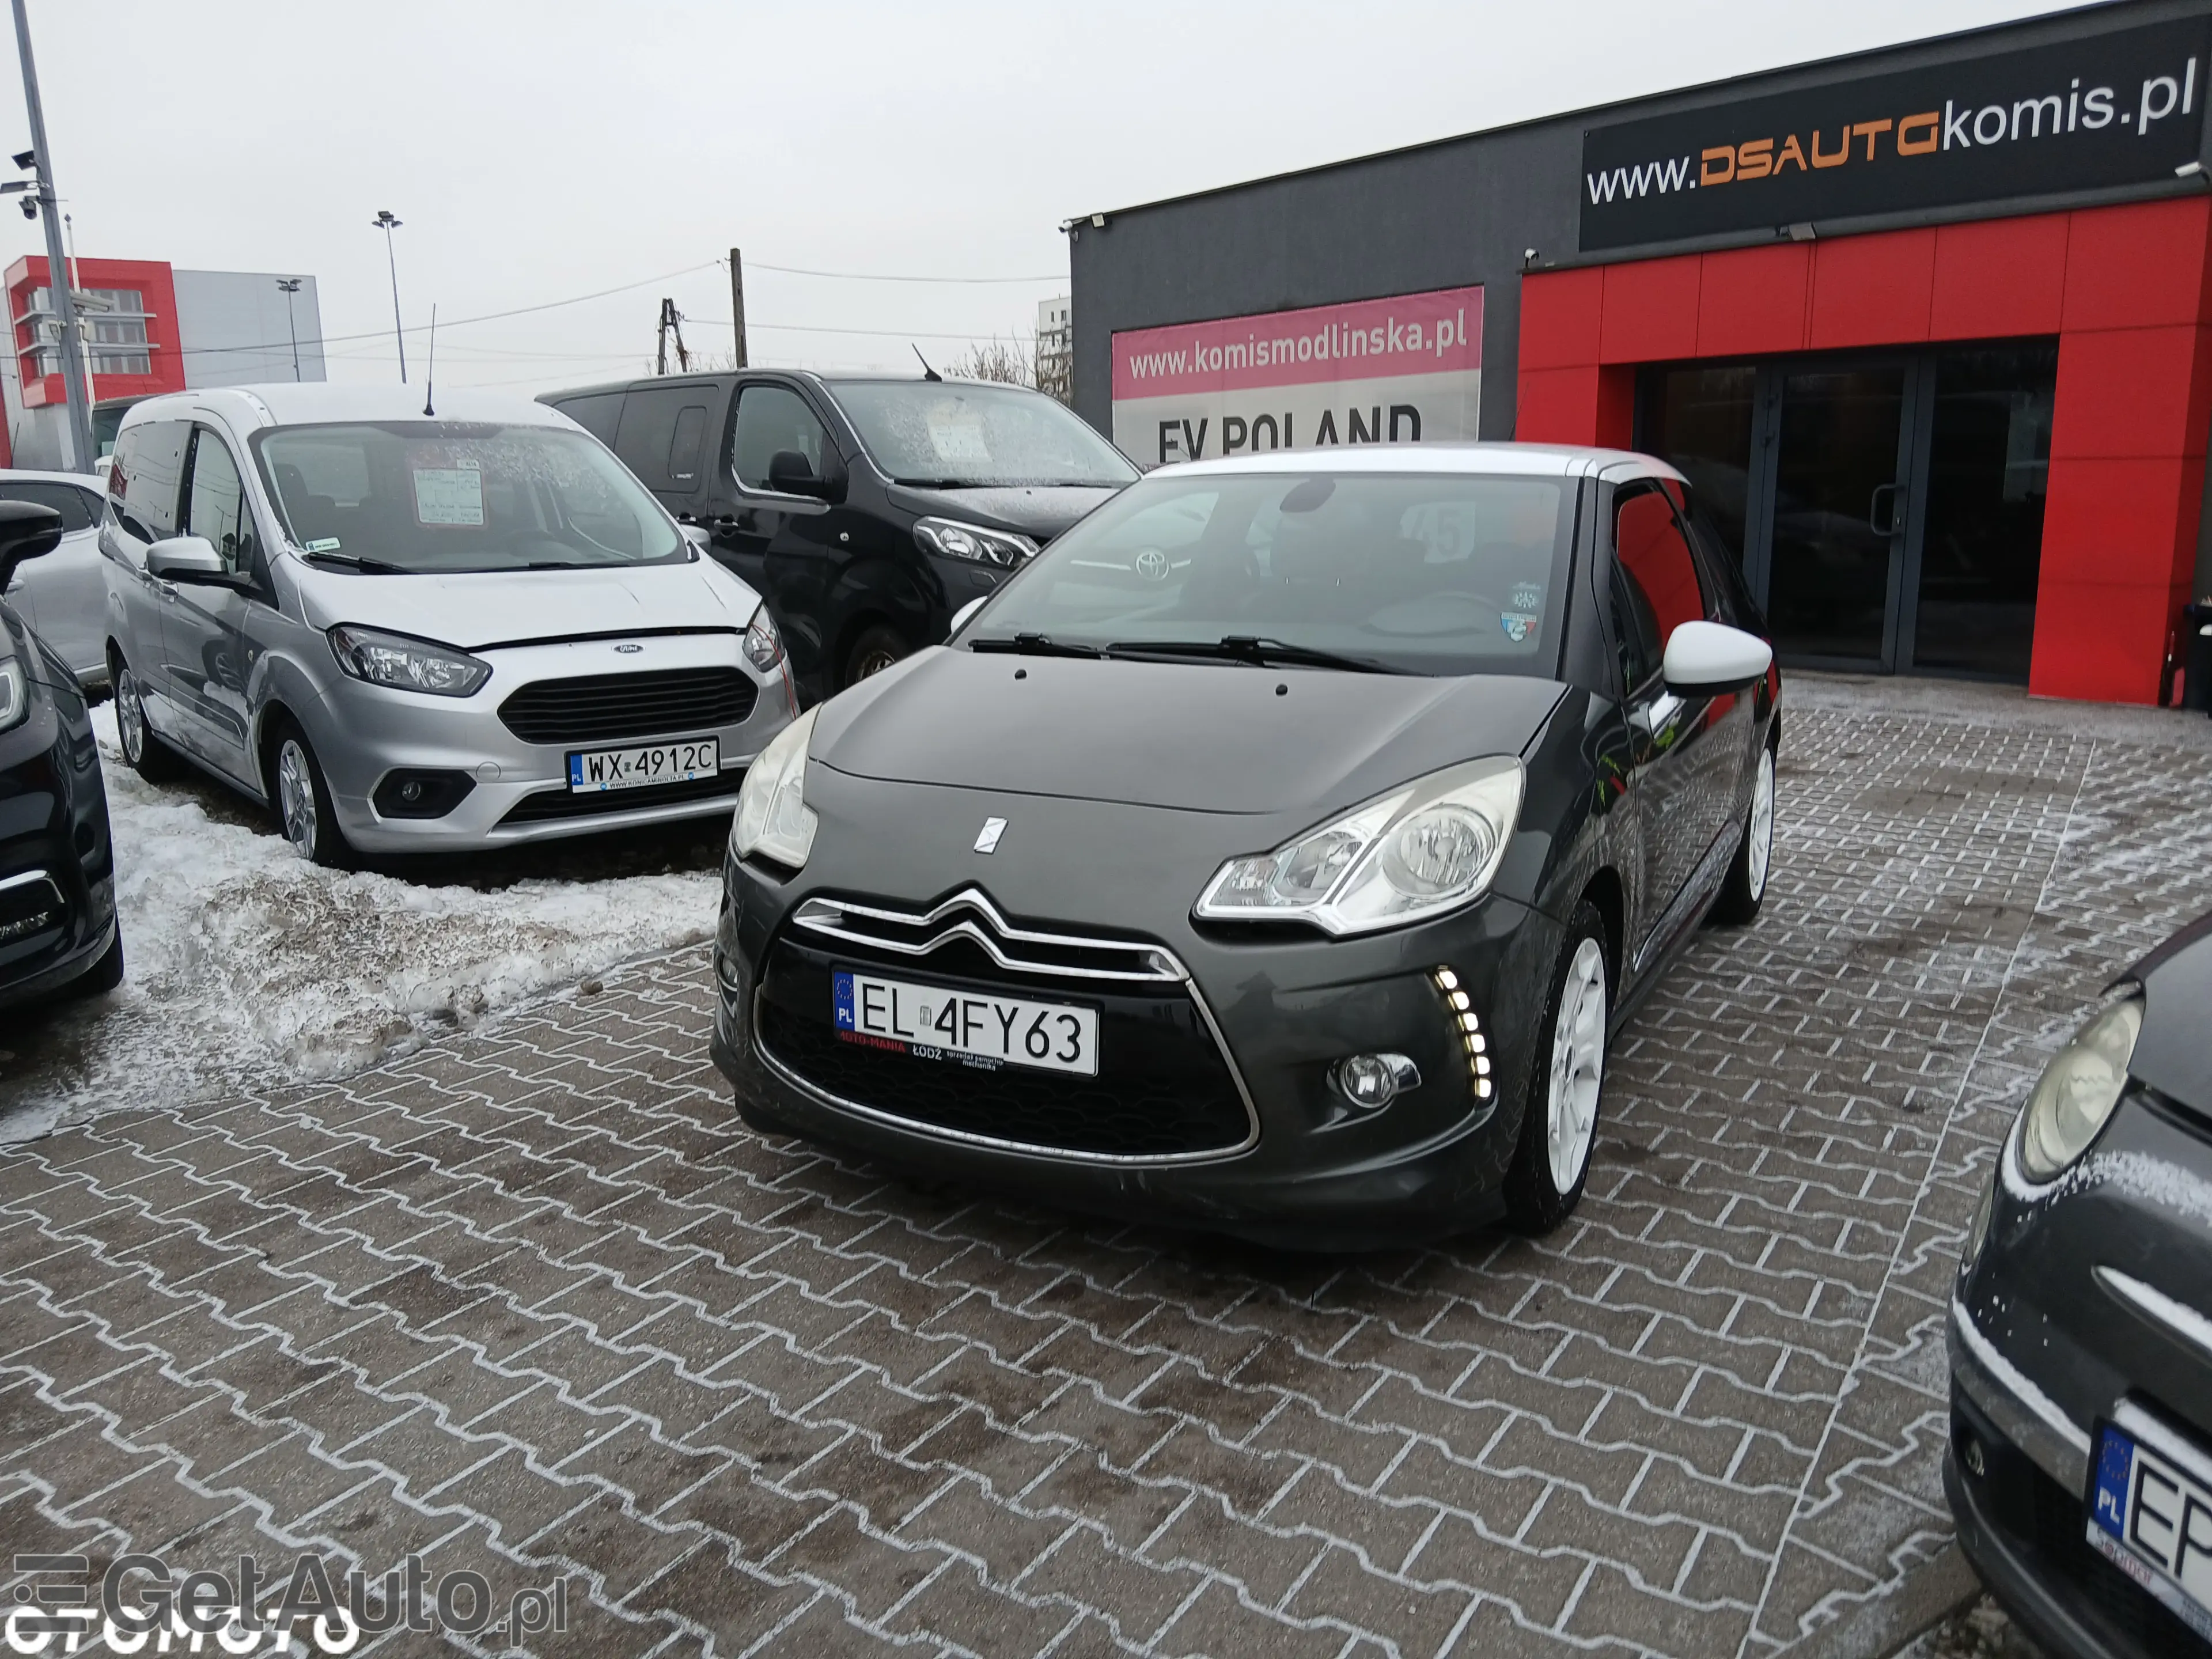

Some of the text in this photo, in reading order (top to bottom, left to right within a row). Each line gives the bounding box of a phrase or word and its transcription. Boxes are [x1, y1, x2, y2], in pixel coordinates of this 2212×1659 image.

[1129, 308, 1467, 380] www.komismodlinska.pl
[571, 774, 581, 782] PL
[589, 744, 712, 782] WX 4912C
[839, 1007, 853, 1024] PL
[863, 983, 1081, 1064] EL 4FY63
[2097, 1487, 2120, 1524] PL
